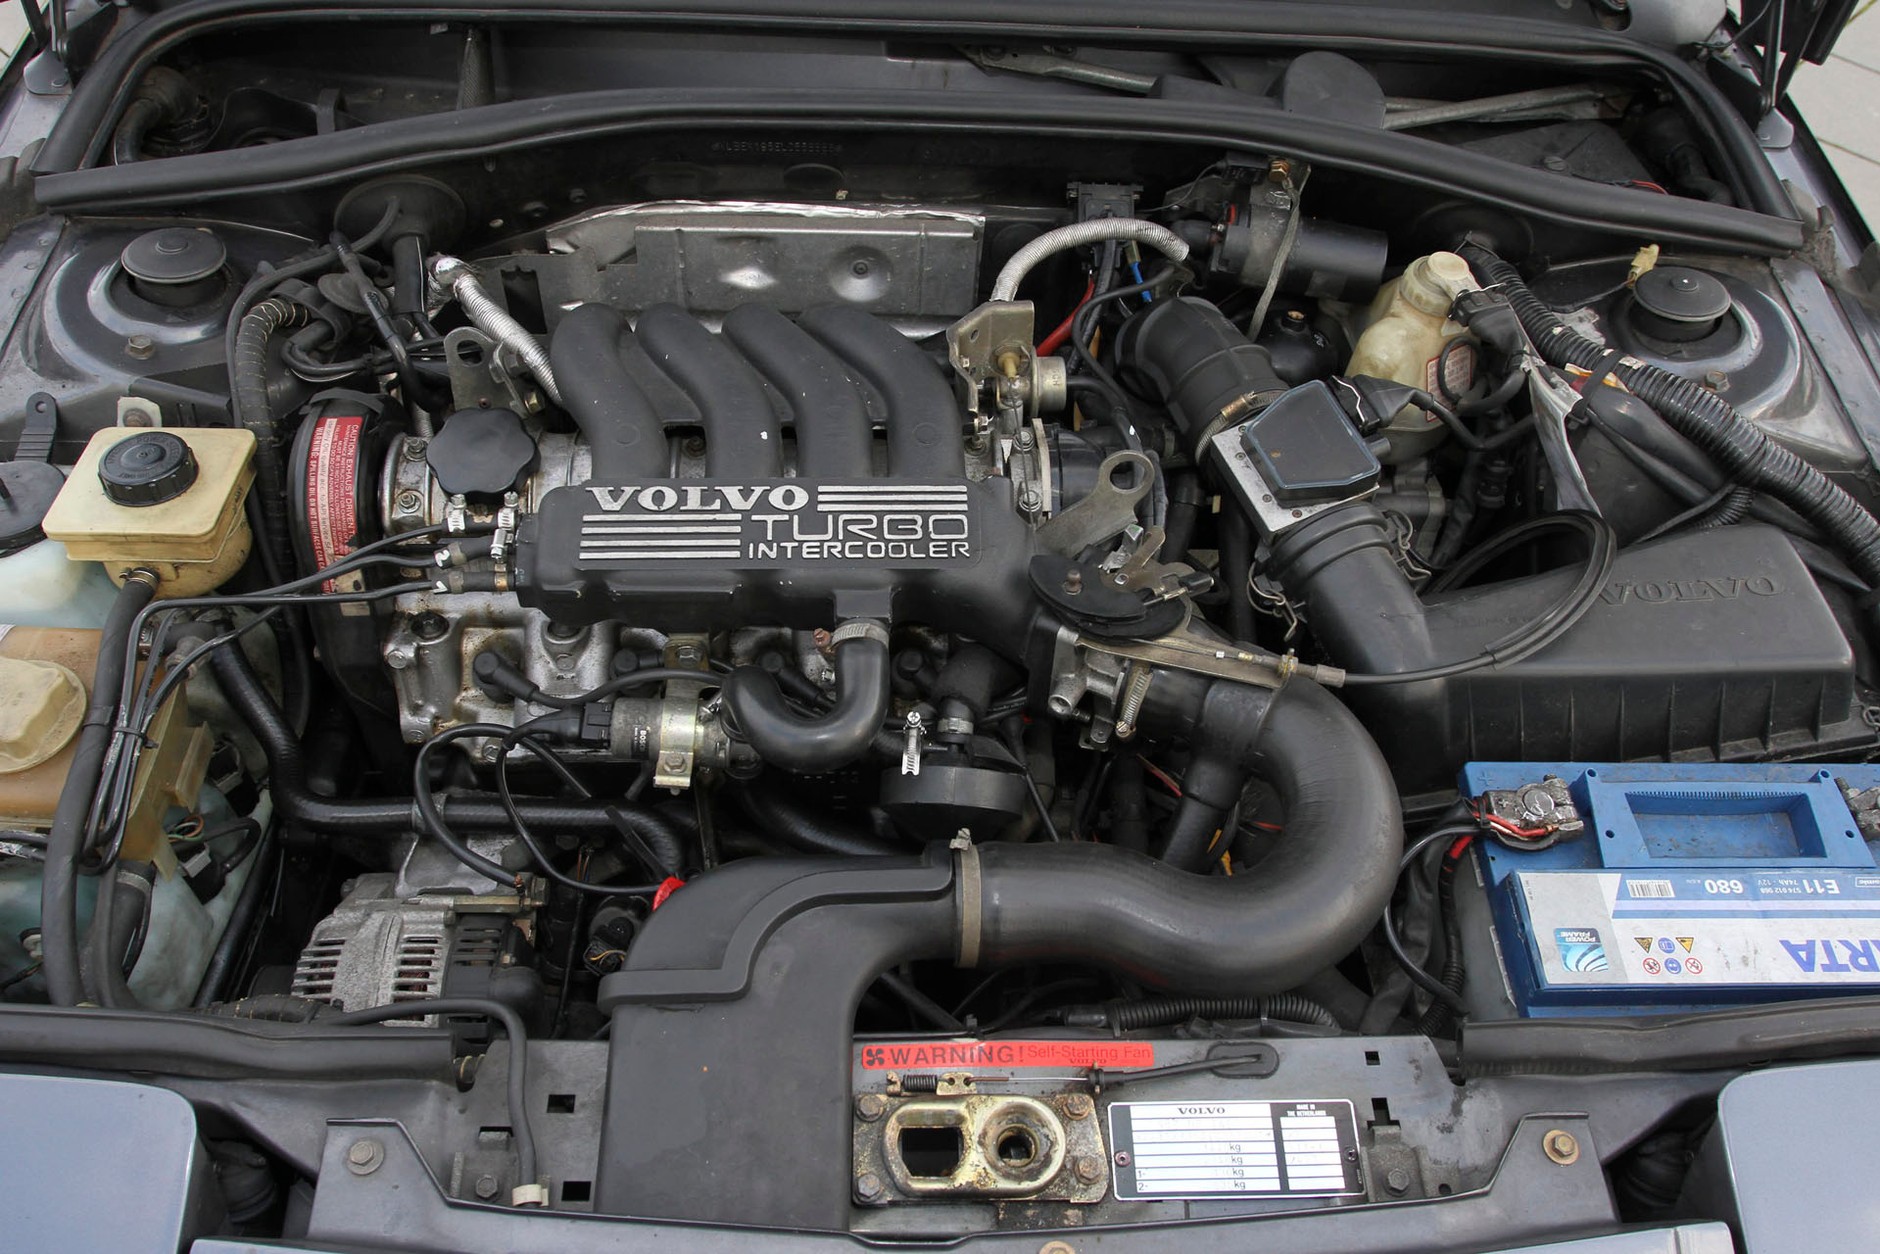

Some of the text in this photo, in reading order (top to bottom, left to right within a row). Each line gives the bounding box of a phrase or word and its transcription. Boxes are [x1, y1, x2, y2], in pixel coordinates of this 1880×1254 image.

[312, 426, 325, 458] WARNING:
[309, 460, 318, 486] SPILLING
[345, 459, 354, 495] EXHAUST
[586, 484, 809, 512] VOLVO
[346, 498, 354, 528] DRIVEN
[310, 520, 320, 550] SURFACES
[751, 514, 968, 541] TURBO
[748, 541, 970, 560] INTERCOOLER
[1598, 577, 1785, 606] VOLVO
[1704, 879, 1744, 894] 680
[1802, 879, 1840, 894] E11
[1028, 1045, 1120, 1060] Self-Starting
[1124, 1044, 1150, 1058] Fan
[1178, 1106, 1226, 1114] VOLVO
[1229, 1143, 1241, 1152] kg
[1231, 1156, 1243, 1165] kg
[1232, 1168, 1244, 1177] kg
[1234, 1180, 1246, 1189] kg
